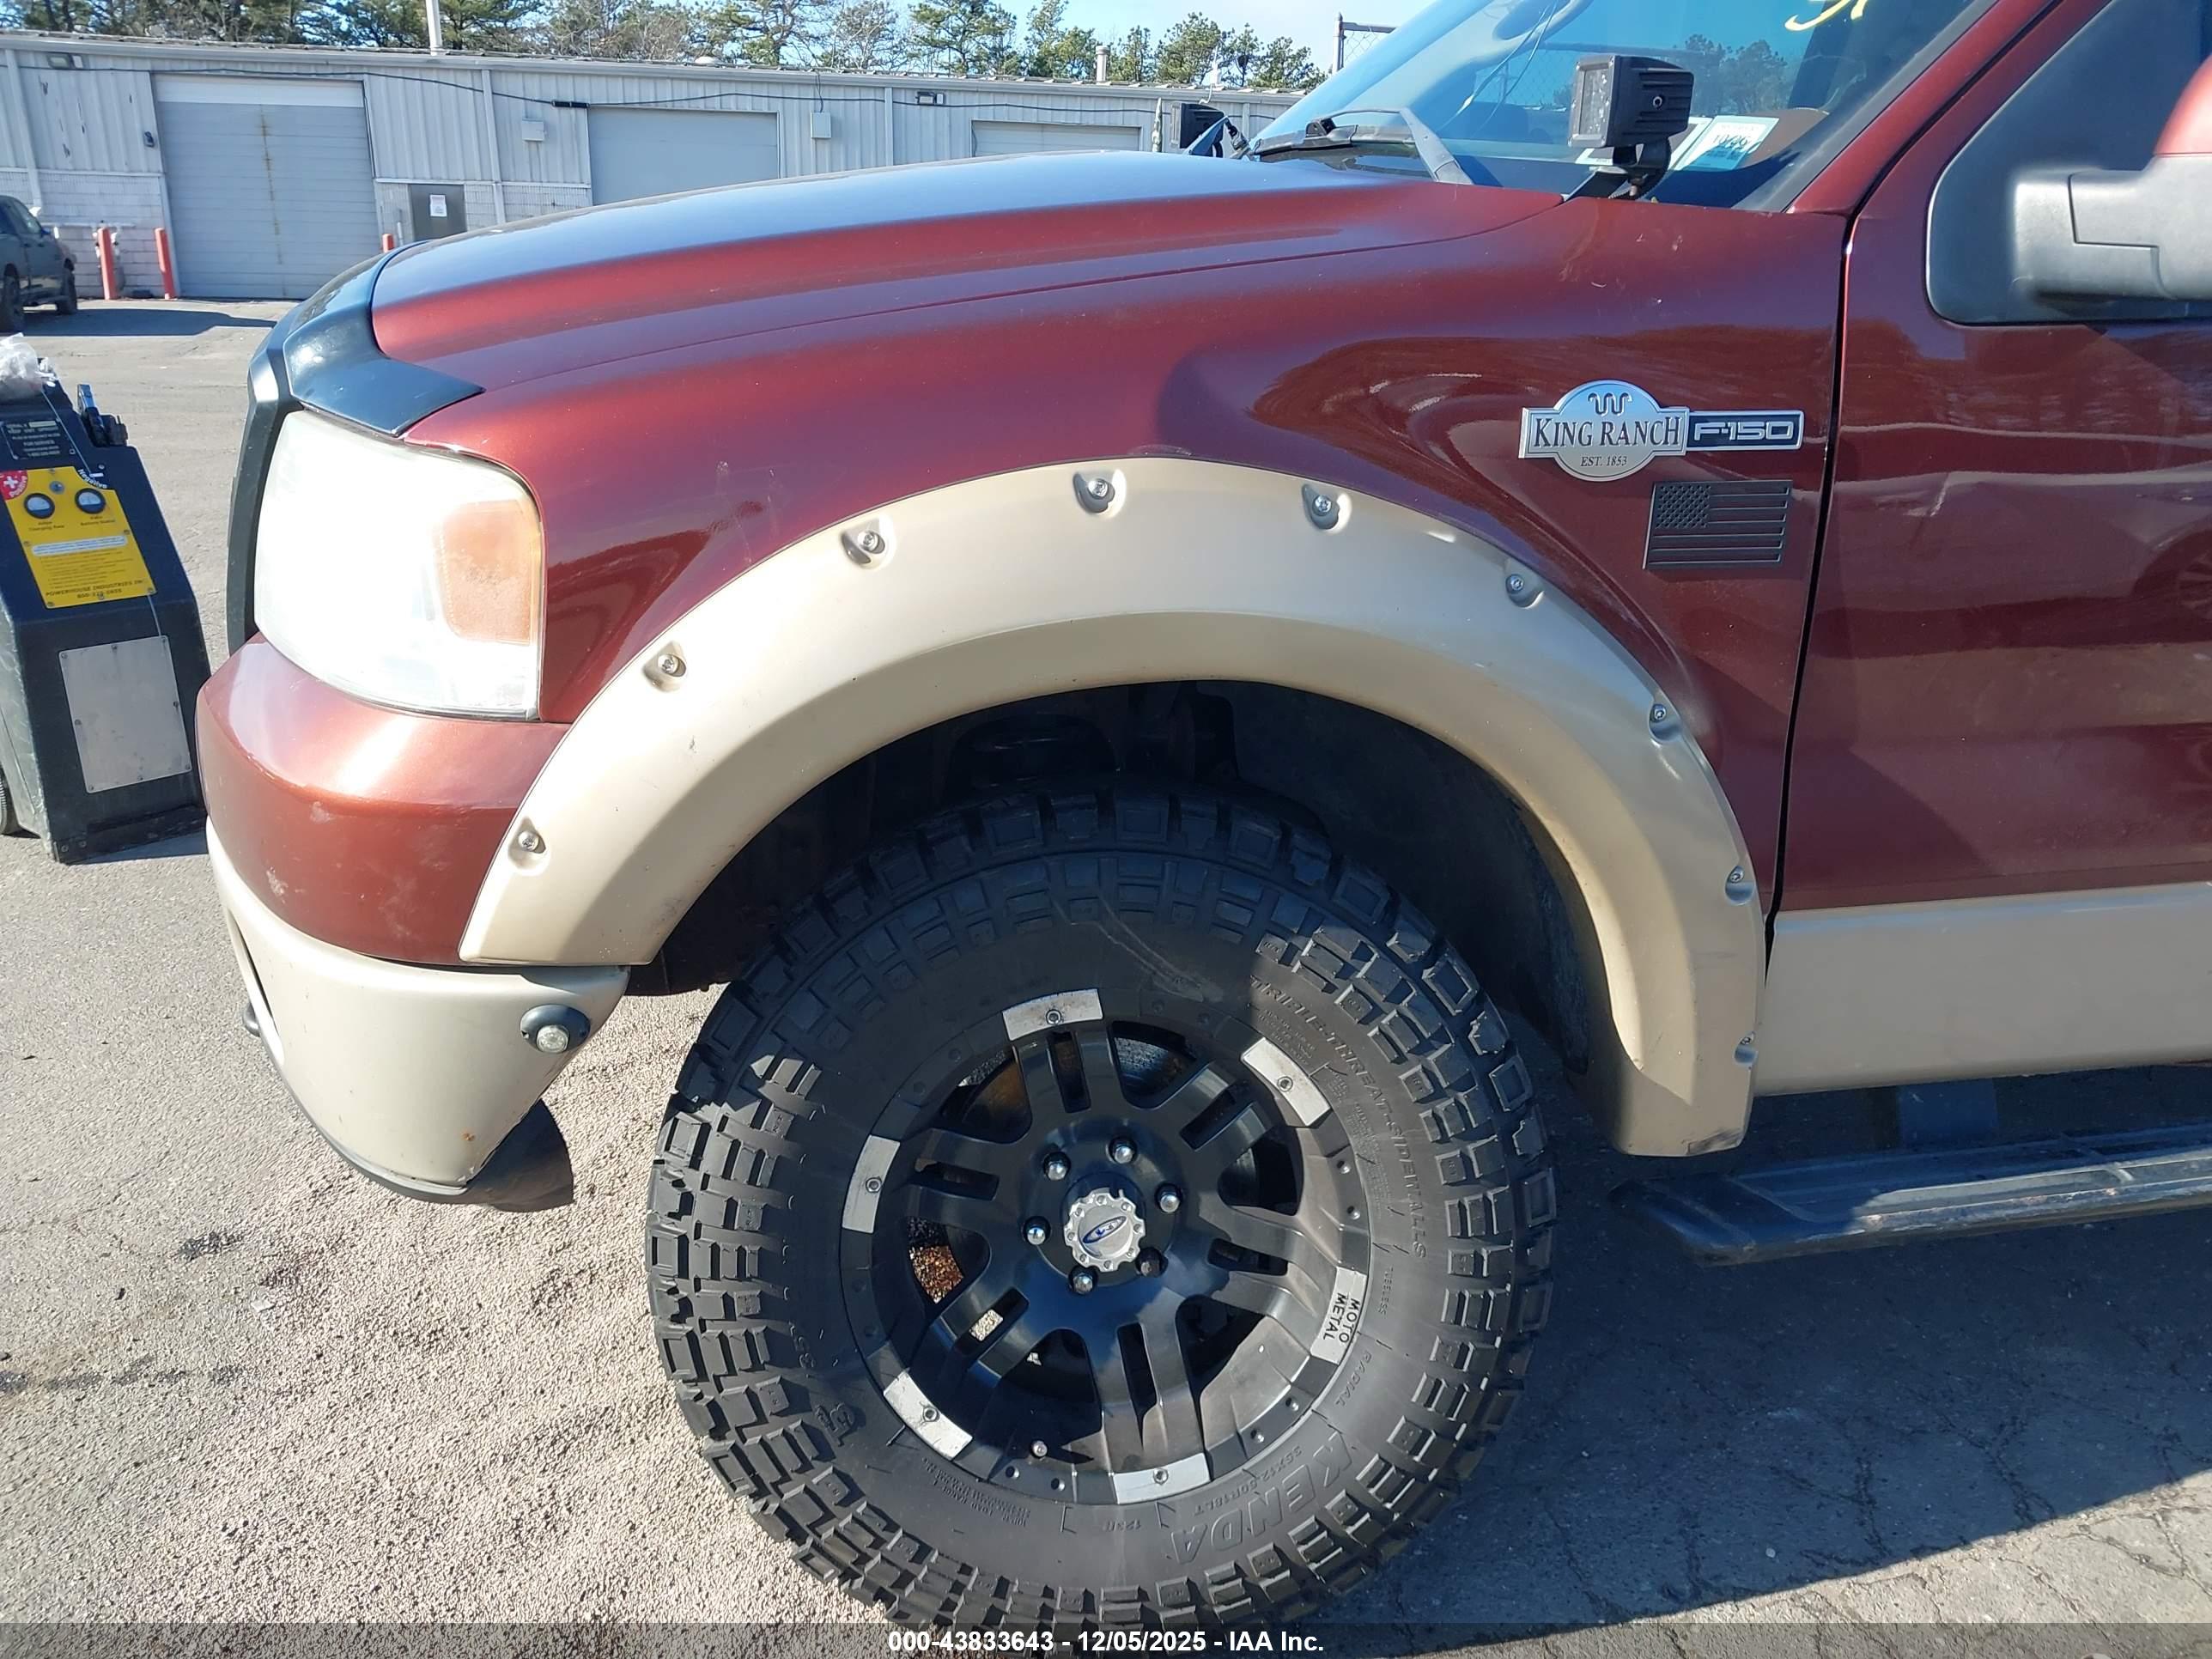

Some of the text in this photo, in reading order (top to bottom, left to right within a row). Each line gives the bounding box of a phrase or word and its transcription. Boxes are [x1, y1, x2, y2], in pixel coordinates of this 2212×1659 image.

[1534, 416, 1682, 447] KING RANCH
[1693, 421, 1794, 441] F-150
[78, 469, 107, 489] Negative
[1580, 455, 1628, 467] EST. 1853
[1322, 1292, 1347, 1341] METAL
[1339, 1297, 1361, 1345] MOTO
[1336, 1349, 1372, 1407] RADIAL
[1170, 1431, 1353, 1565] KENDA
